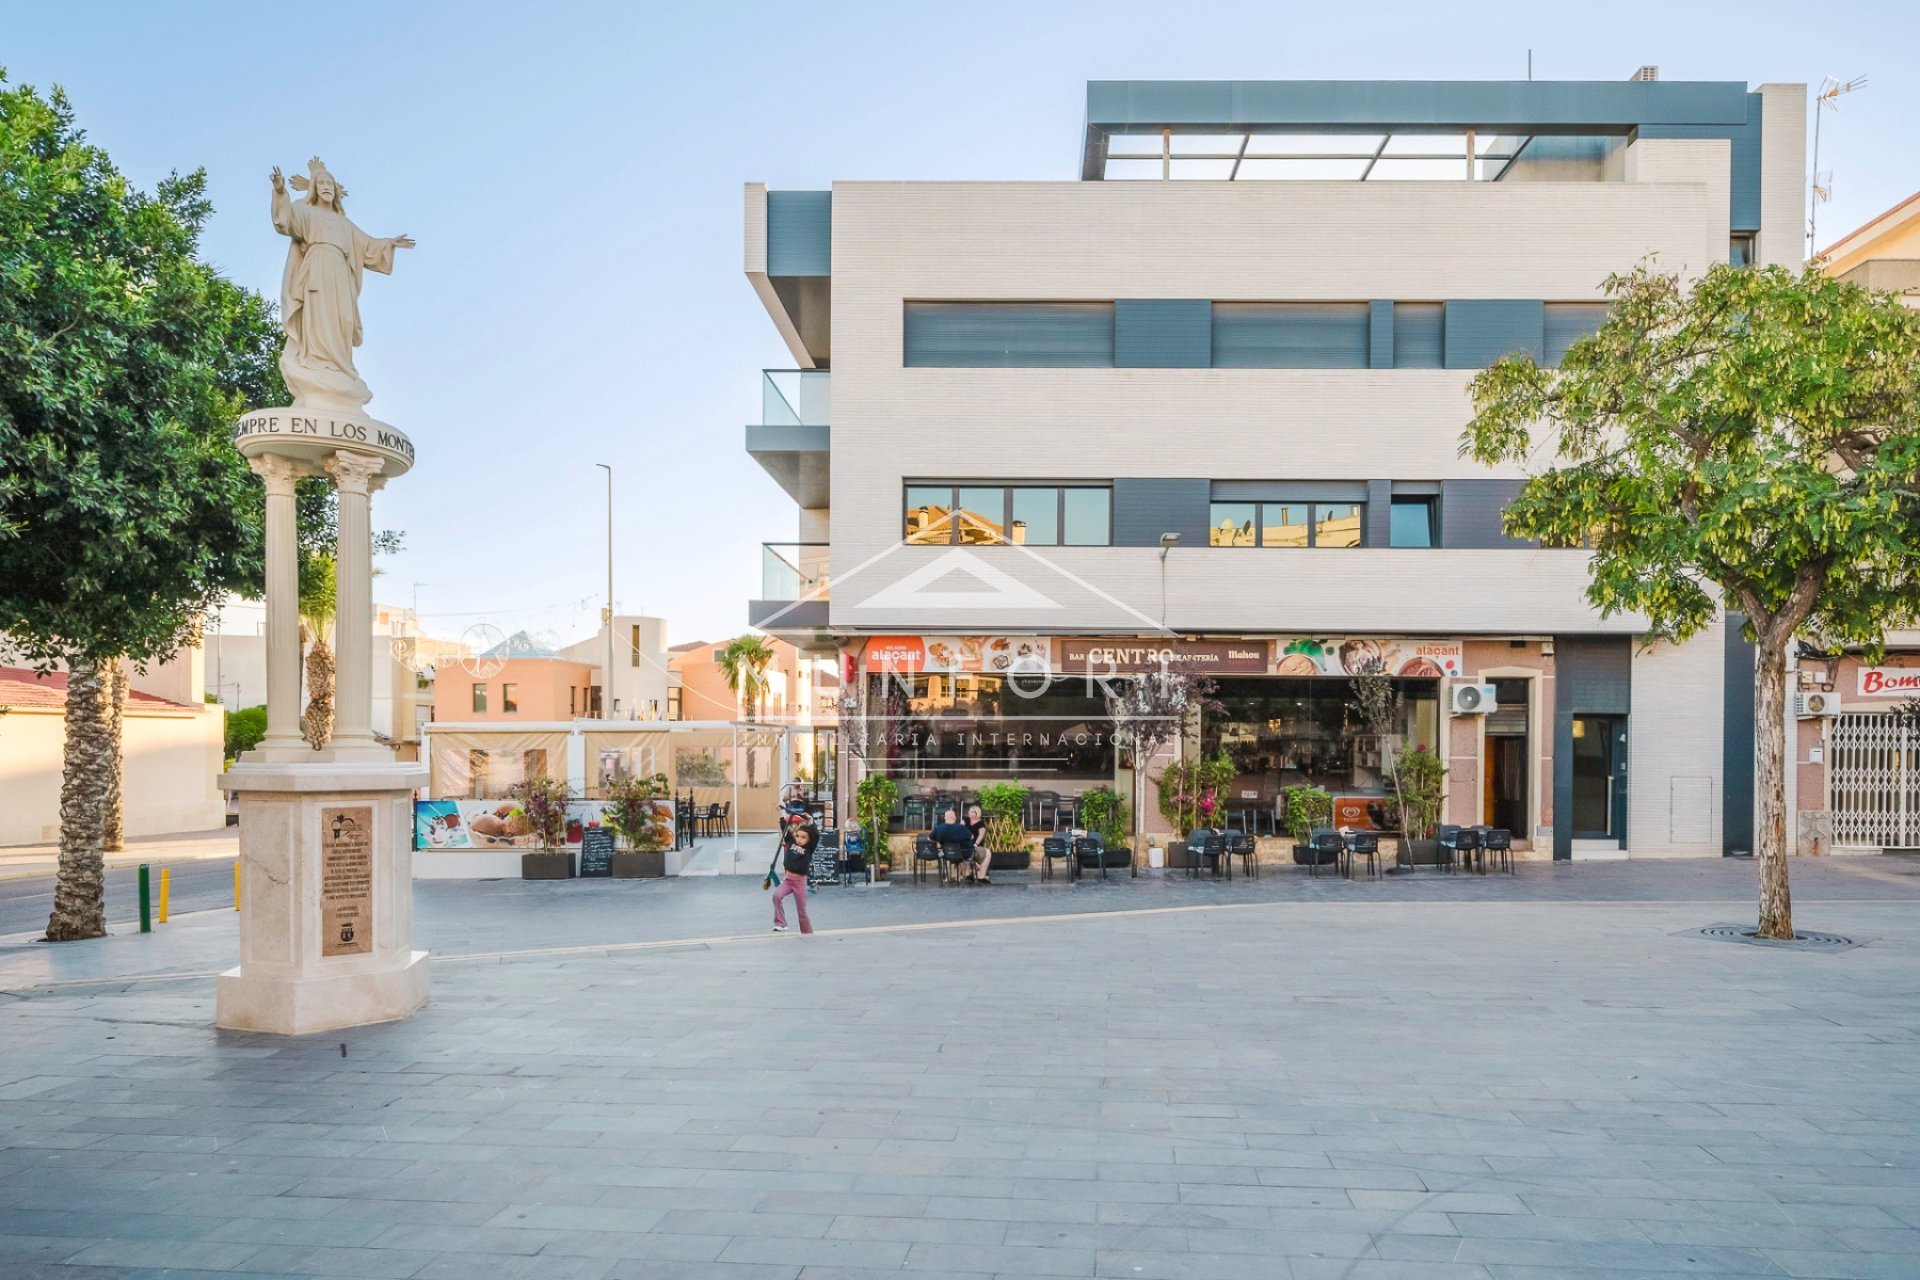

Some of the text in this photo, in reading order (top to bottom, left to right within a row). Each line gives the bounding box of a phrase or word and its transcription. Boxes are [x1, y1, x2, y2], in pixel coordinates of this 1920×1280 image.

[291, 417, 318, 434] EN
[330, 421, 367, 441] LOS
[871, 649, 921, 665] alaçant
[1069, 653, 1085, 661] BAR
[1088, 647, 1175, 665] CENTRO
[1228, 650, 1260, 659] Mahou
[1415, 646, 1460, 659] alaçant
